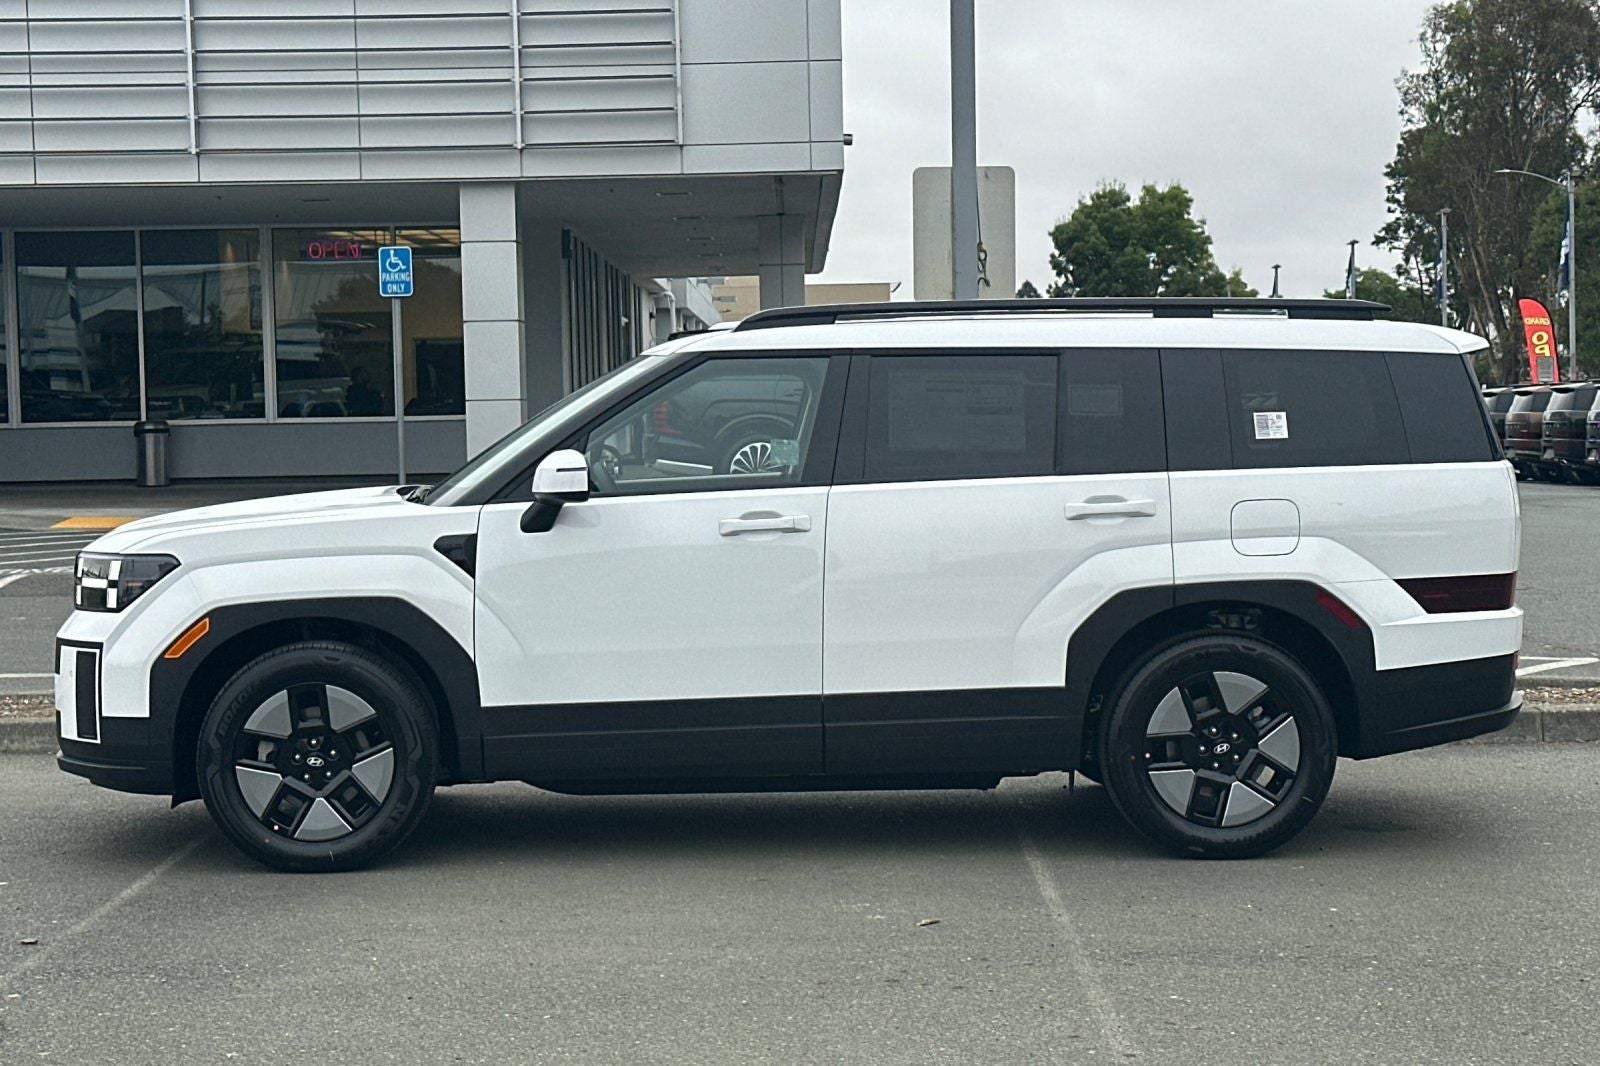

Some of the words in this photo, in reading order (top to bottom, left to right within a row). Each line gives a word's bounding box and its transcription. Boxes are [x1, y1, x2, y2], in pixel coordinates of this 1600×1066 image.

[308, 241, 359, 259] OPEN
[381, 272, 410, 282] PARKING
[387, 283, 405, 293] ONLY
